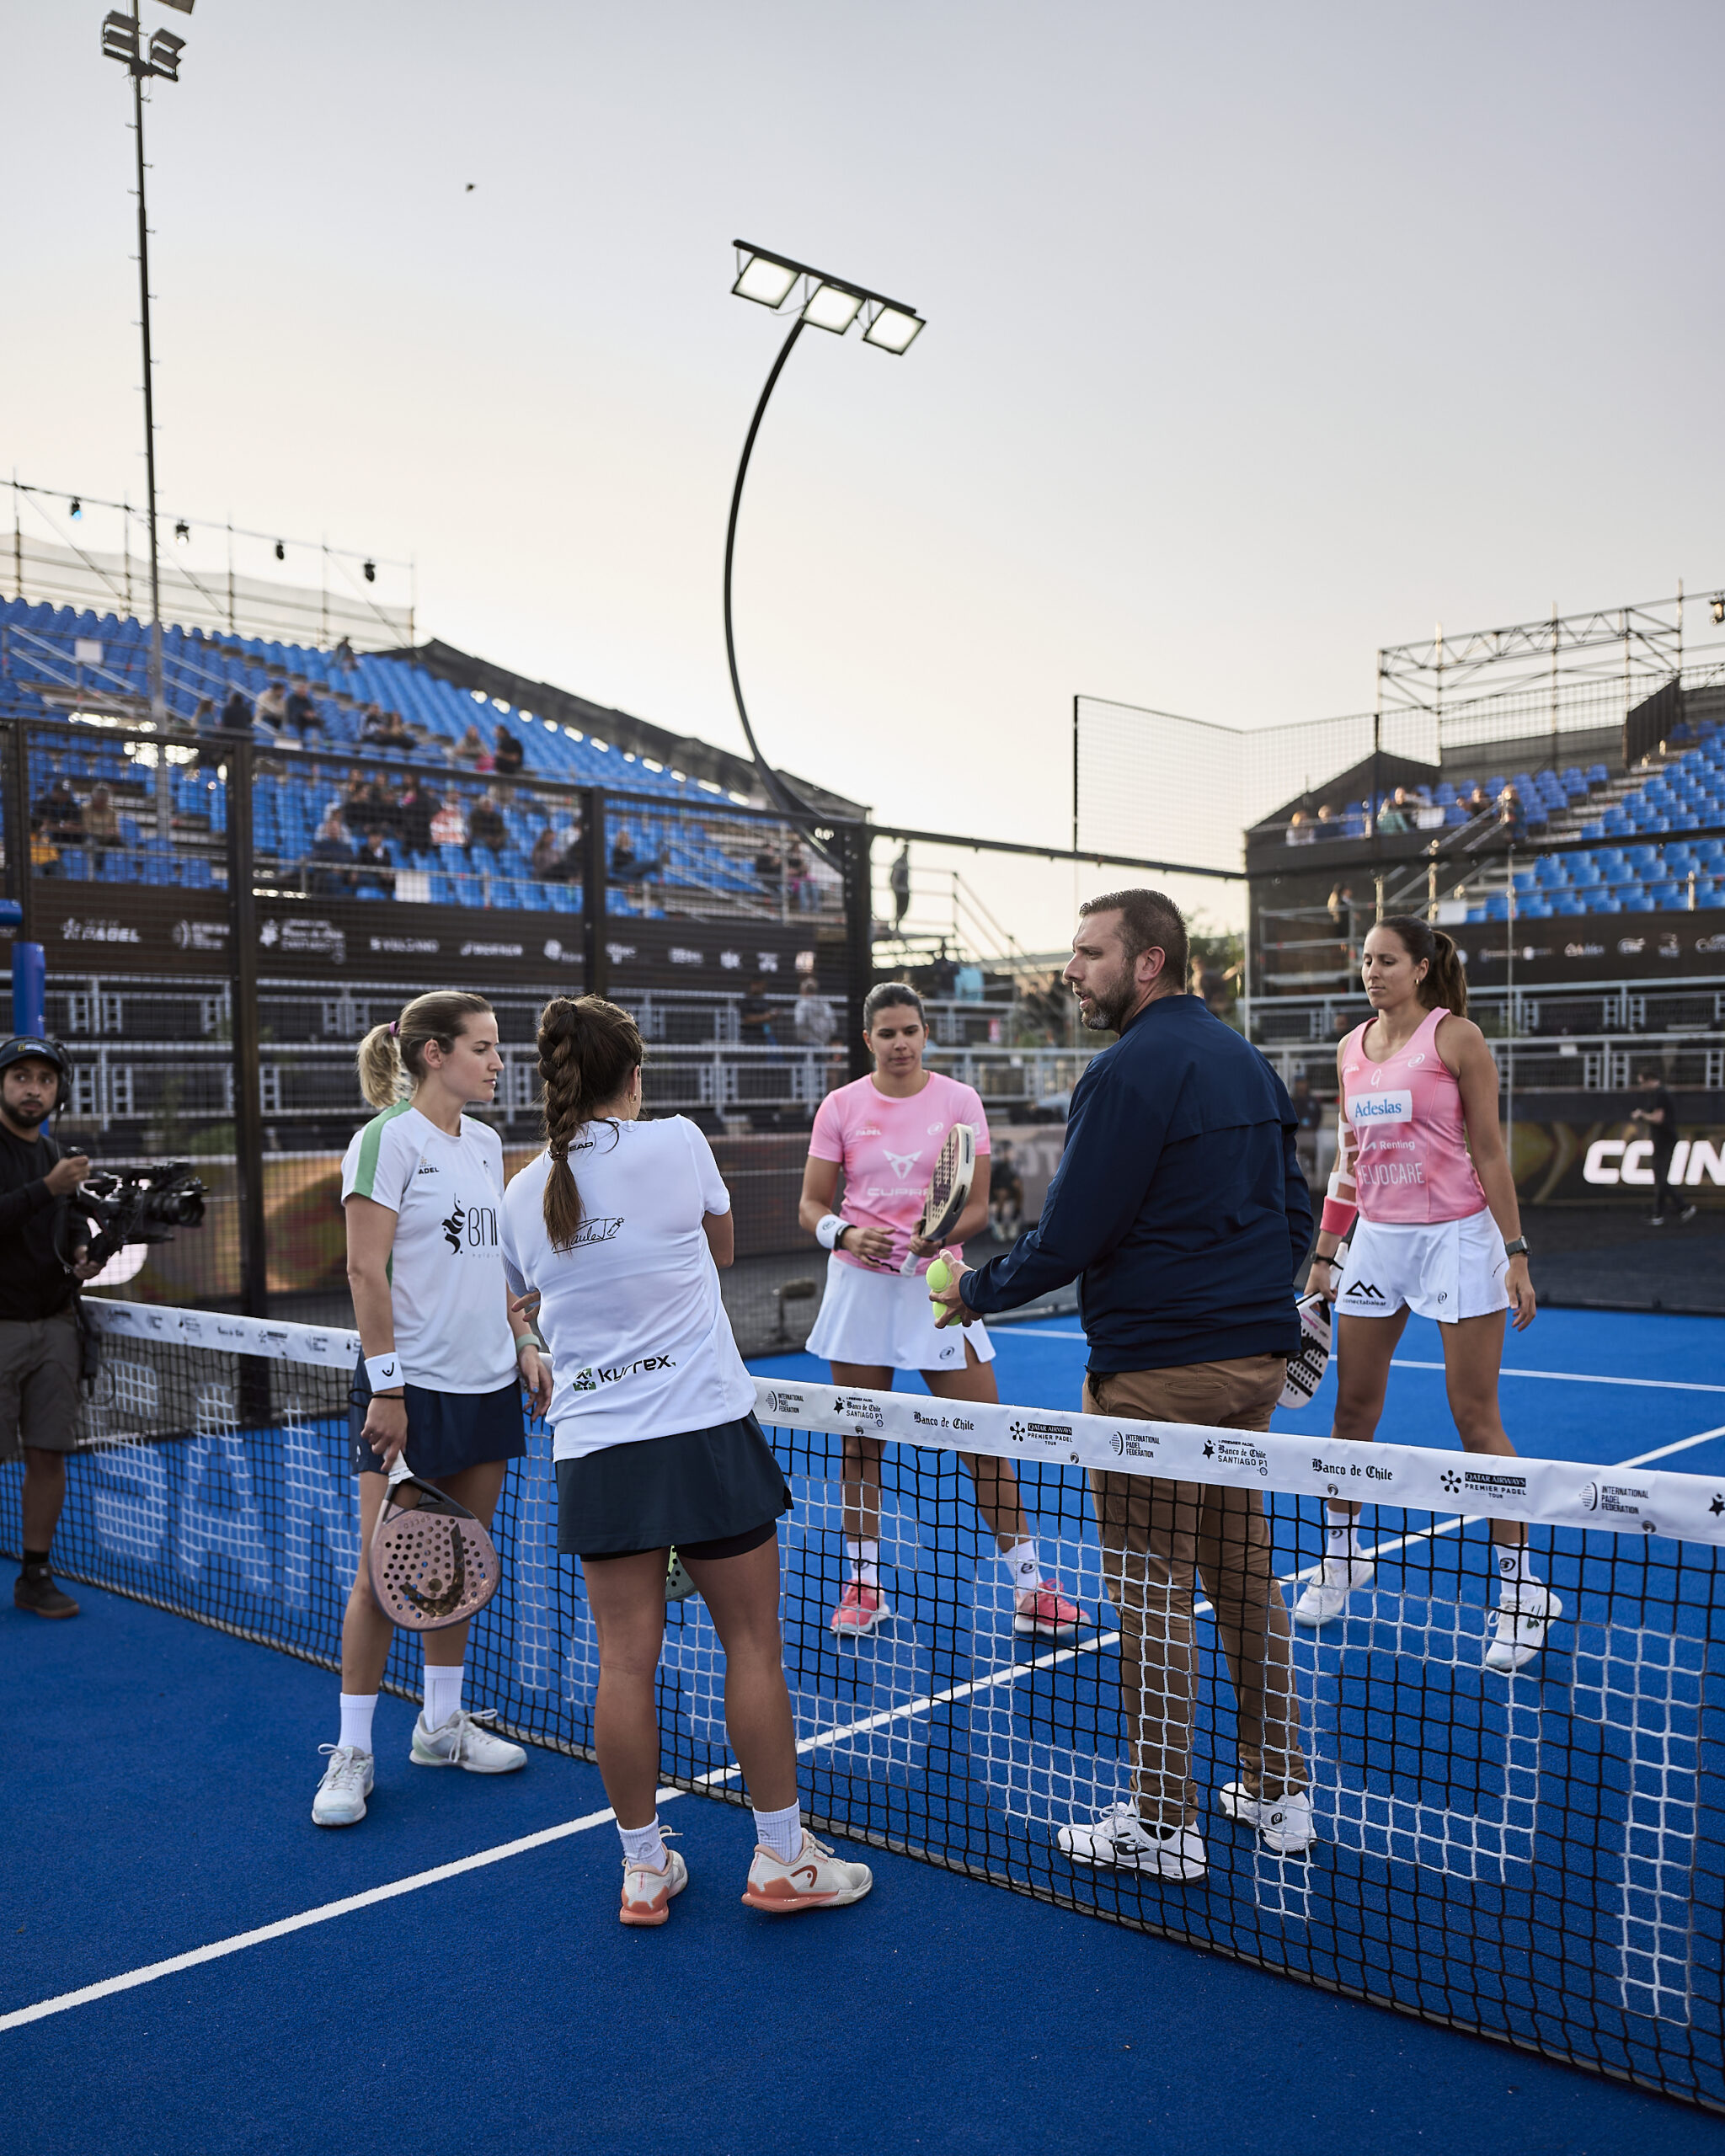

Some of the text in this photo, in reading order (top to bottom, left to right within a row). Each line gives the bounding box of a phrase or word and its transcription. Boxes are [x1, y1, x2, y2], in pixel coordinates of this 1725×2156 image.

[1355, 1098, 1402, 1118] Adeslas
[569, 1141, 593, 1152] EAD
[1380, 1140, 1415, 1150] Renting
[846, 1410, 873, 1419] SANTIAGO
[913, 1412, 975, 1431] Banco de Chile
[1028, 1423, 1047, 1432] QATAR
[1125, 1434, 1160, 1444] INTERNATIONAL
[1126, 1449, 1154, 1458] FEDERATION
[1218, 1444, 1266, 1459] Banco de Chile
[1218, 1454, 1268, 1467] SANTIAGO P1
[1311, 1458, 1393, 1481] Banco de Chile
[1466, 1473, 1525, 1486] QATAR AIRWAYS
[1465, 1483, 1527, 1496] PREMIER PADEL
[1602, 1485, 1650, 1499] INTERNATIONAL
[1601, 1494, 1621, 1504] PADEL
[1601, 1502, 1640, 1515] FEDERATION
